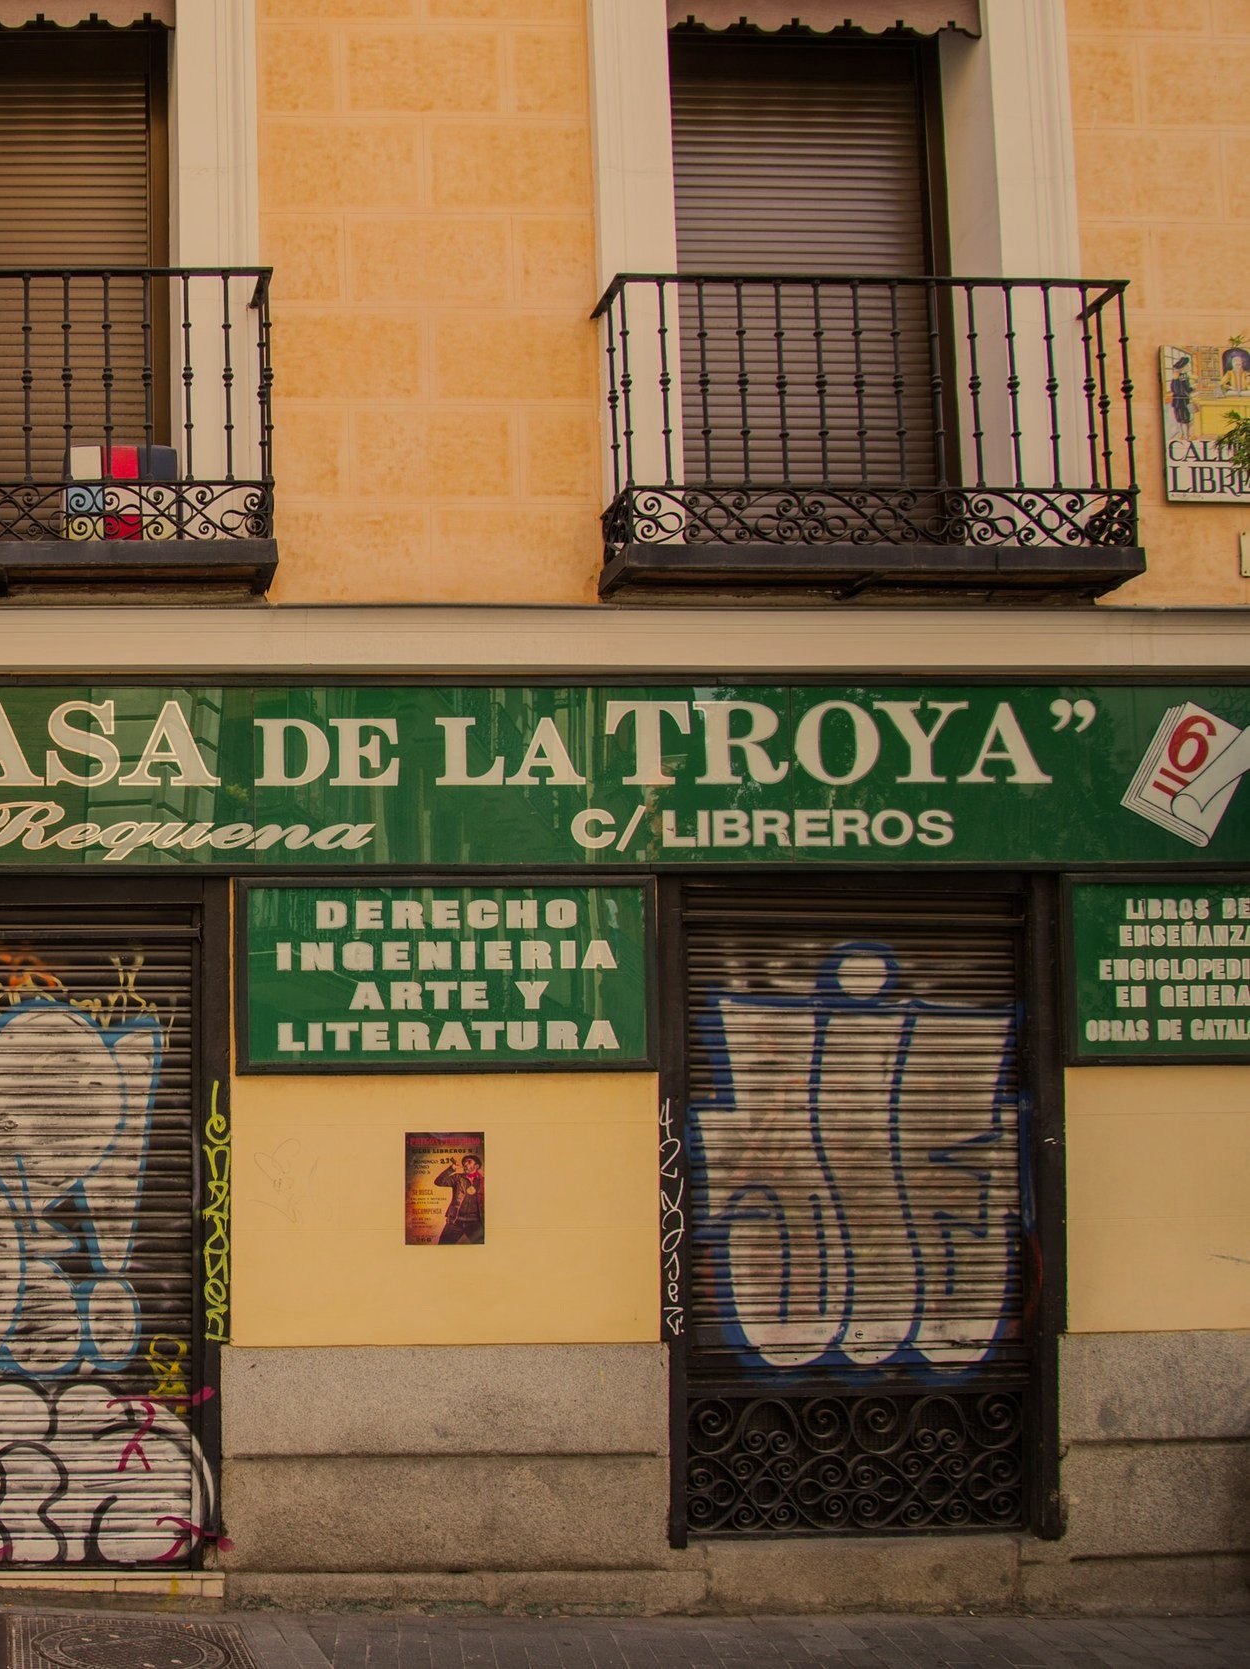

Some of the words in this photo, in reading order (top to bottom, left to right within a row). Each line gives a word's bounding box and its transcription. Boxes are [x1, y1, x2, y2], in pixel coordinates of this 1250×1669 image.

[254, 718, 399, 786] DE
[436, 717, 588, 785] LA
[1167, 715, 1217, 773] 6
[570, 805, 646, 851] C/
[661, 809, 953, 847] LIBREROS
[317, 900, 577, 929] DERECHO
[1126, 898, 1210, 920] LIBROS
[278, 939, 617, 970] INGENIERIA
[349, 982, 488, 1010] ARTE
[515, 981, 550, 1010] Y
[1116, 986, 1147, 1008] EN
[279, 1019, 620, 1051] LITERATURA
[1086, 1019, 1150, 1041] OBRAS
[1157, 1019, 1183, 1041] DE
